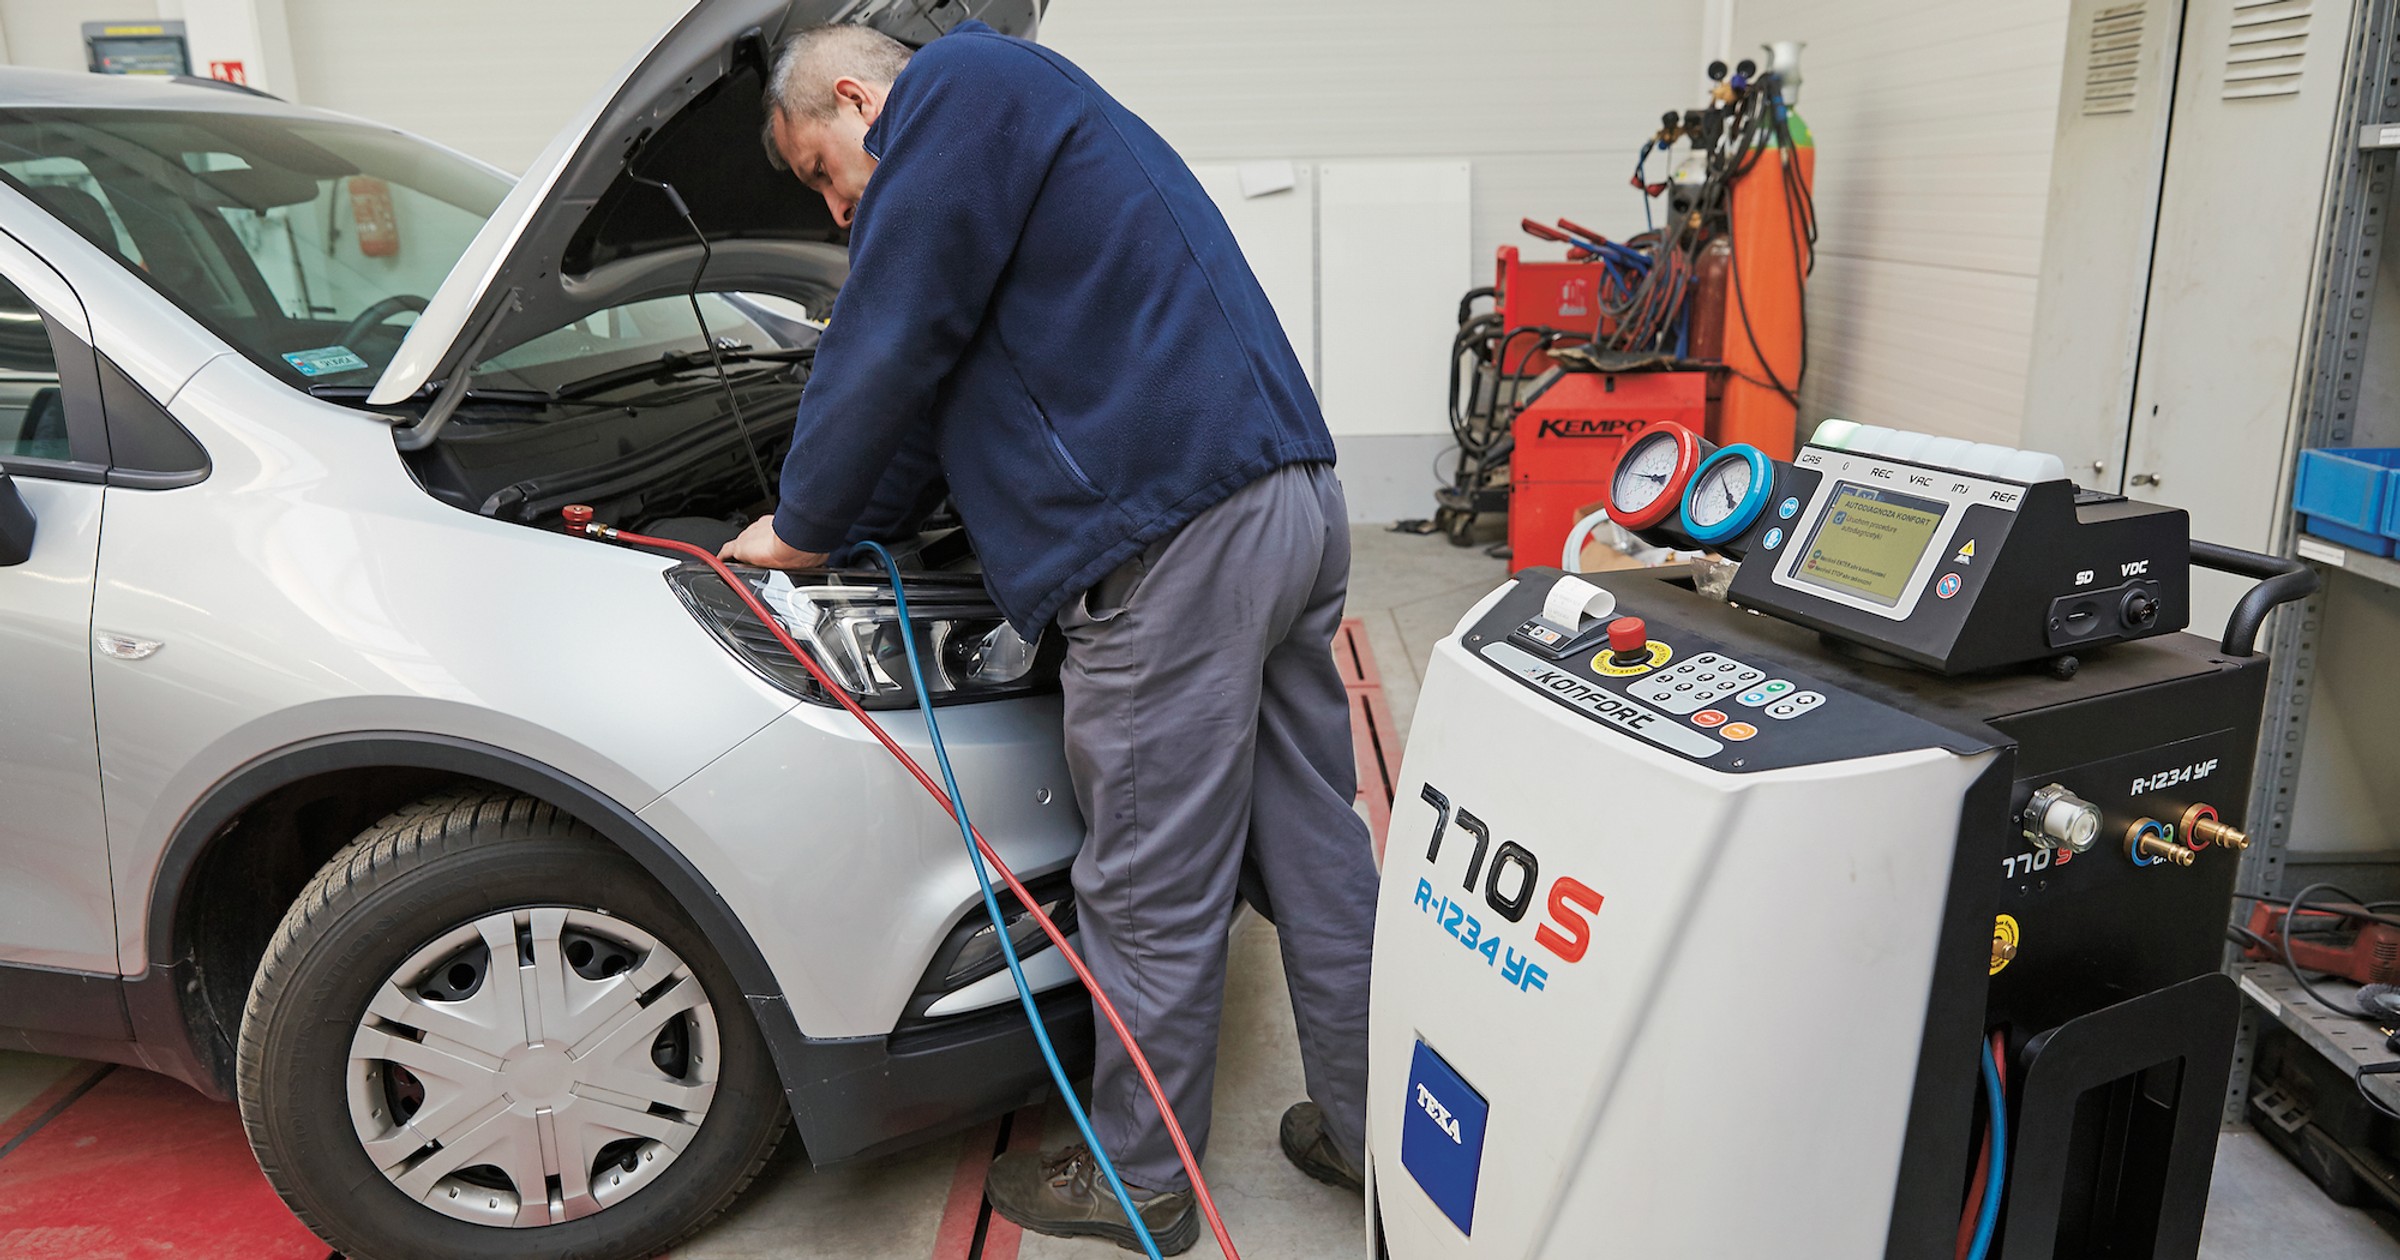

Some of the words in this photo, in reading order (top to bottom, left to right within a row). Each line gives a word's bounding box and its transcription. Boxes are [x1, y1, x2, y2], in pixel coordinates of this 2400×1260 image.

[1801, 454, 1822, 465] GAS
[1870, 467, 1894, 479] REC
[1909, 475, 1933, 487] VAC
[1951, 483, 1970, 495] INJ
[1990, 490, 2017, 503] REF
[1845, 501, 1896, 518] AUTODIAGNOZA
[1897, 510, 1932, 526] KONFORT
[2121, 560, 2149, 577] VDC
[2075, 570, 2094, 585] SD
[2130, 764, 2193, 796] R-1234
[2193, 758, 2219, 780] YF
[2002, 848, 2051, 879] 770
[1420, 781, 1538, 924] 770
[1534, 876, 1605, 964] S
[1414, 876, 1501, 968] R-1234
[1500, 946, 1548, 993] YF
[1415, 1082, 1463, 1145] TEXA
